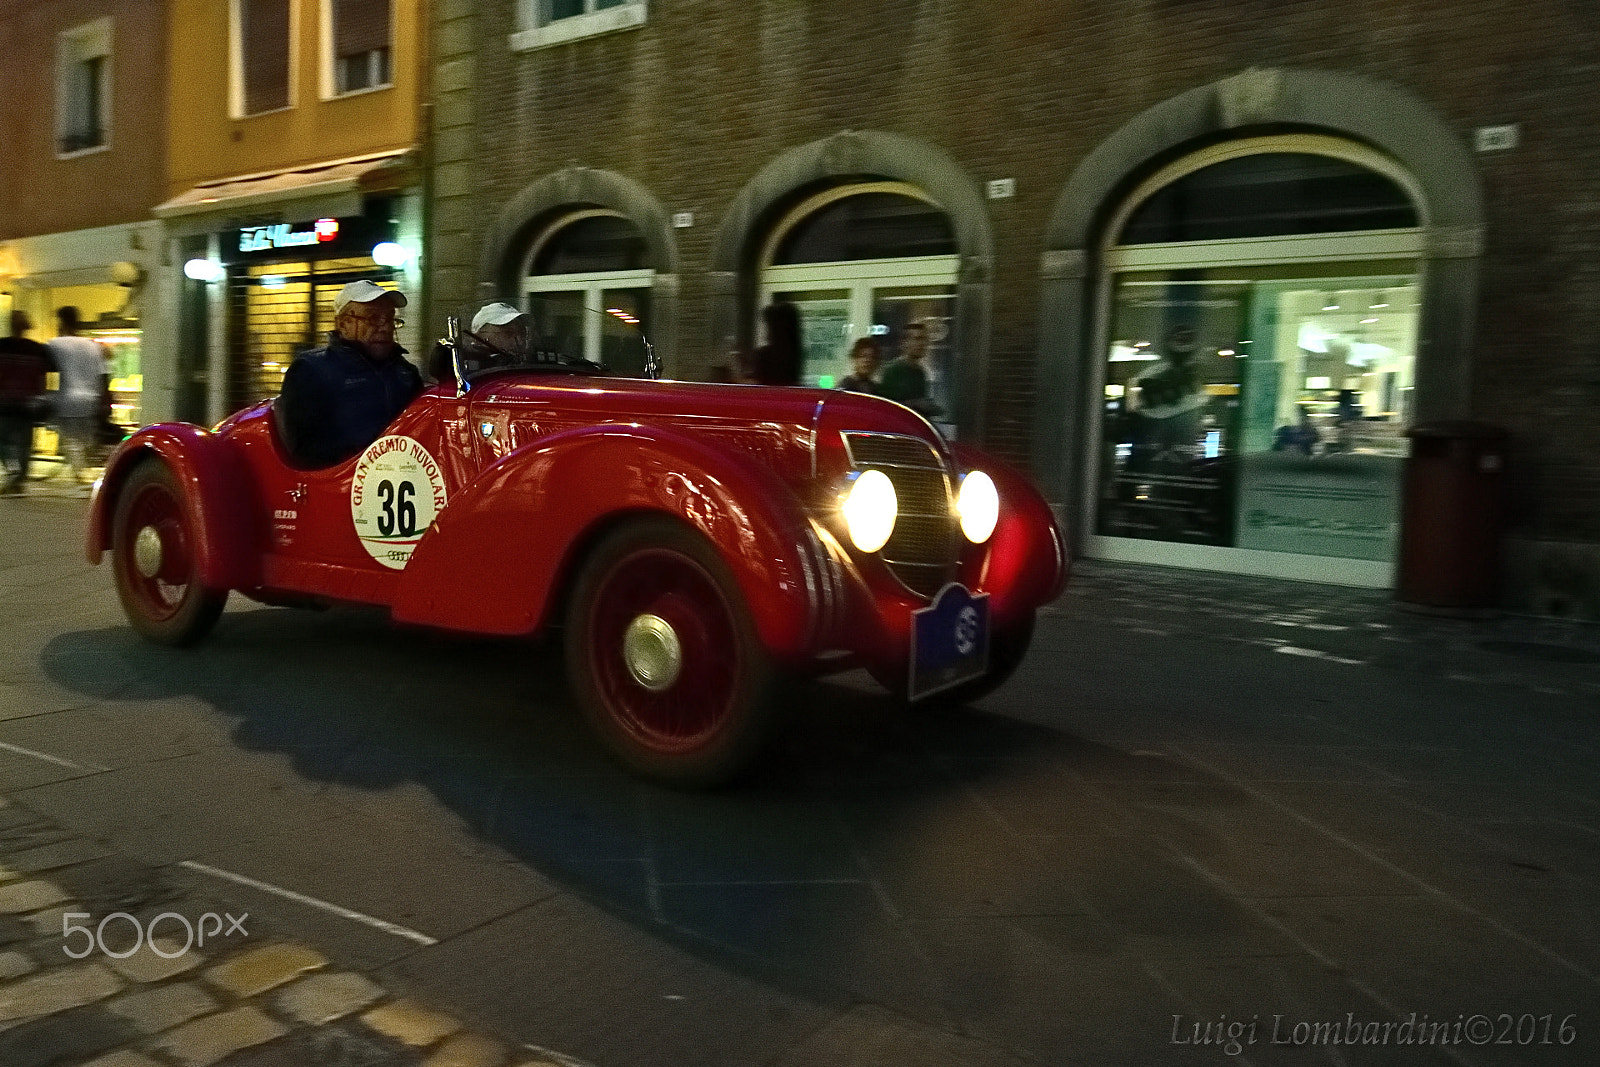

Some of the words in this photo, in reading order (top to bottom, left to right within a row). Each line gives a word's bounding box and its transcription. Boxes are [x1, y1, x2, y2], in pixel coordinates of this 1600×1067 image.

[353, 463, 370, 506] GRAN
[366, 439, 408, 464] PREMIO
[377, 479, 416, 538] 36
